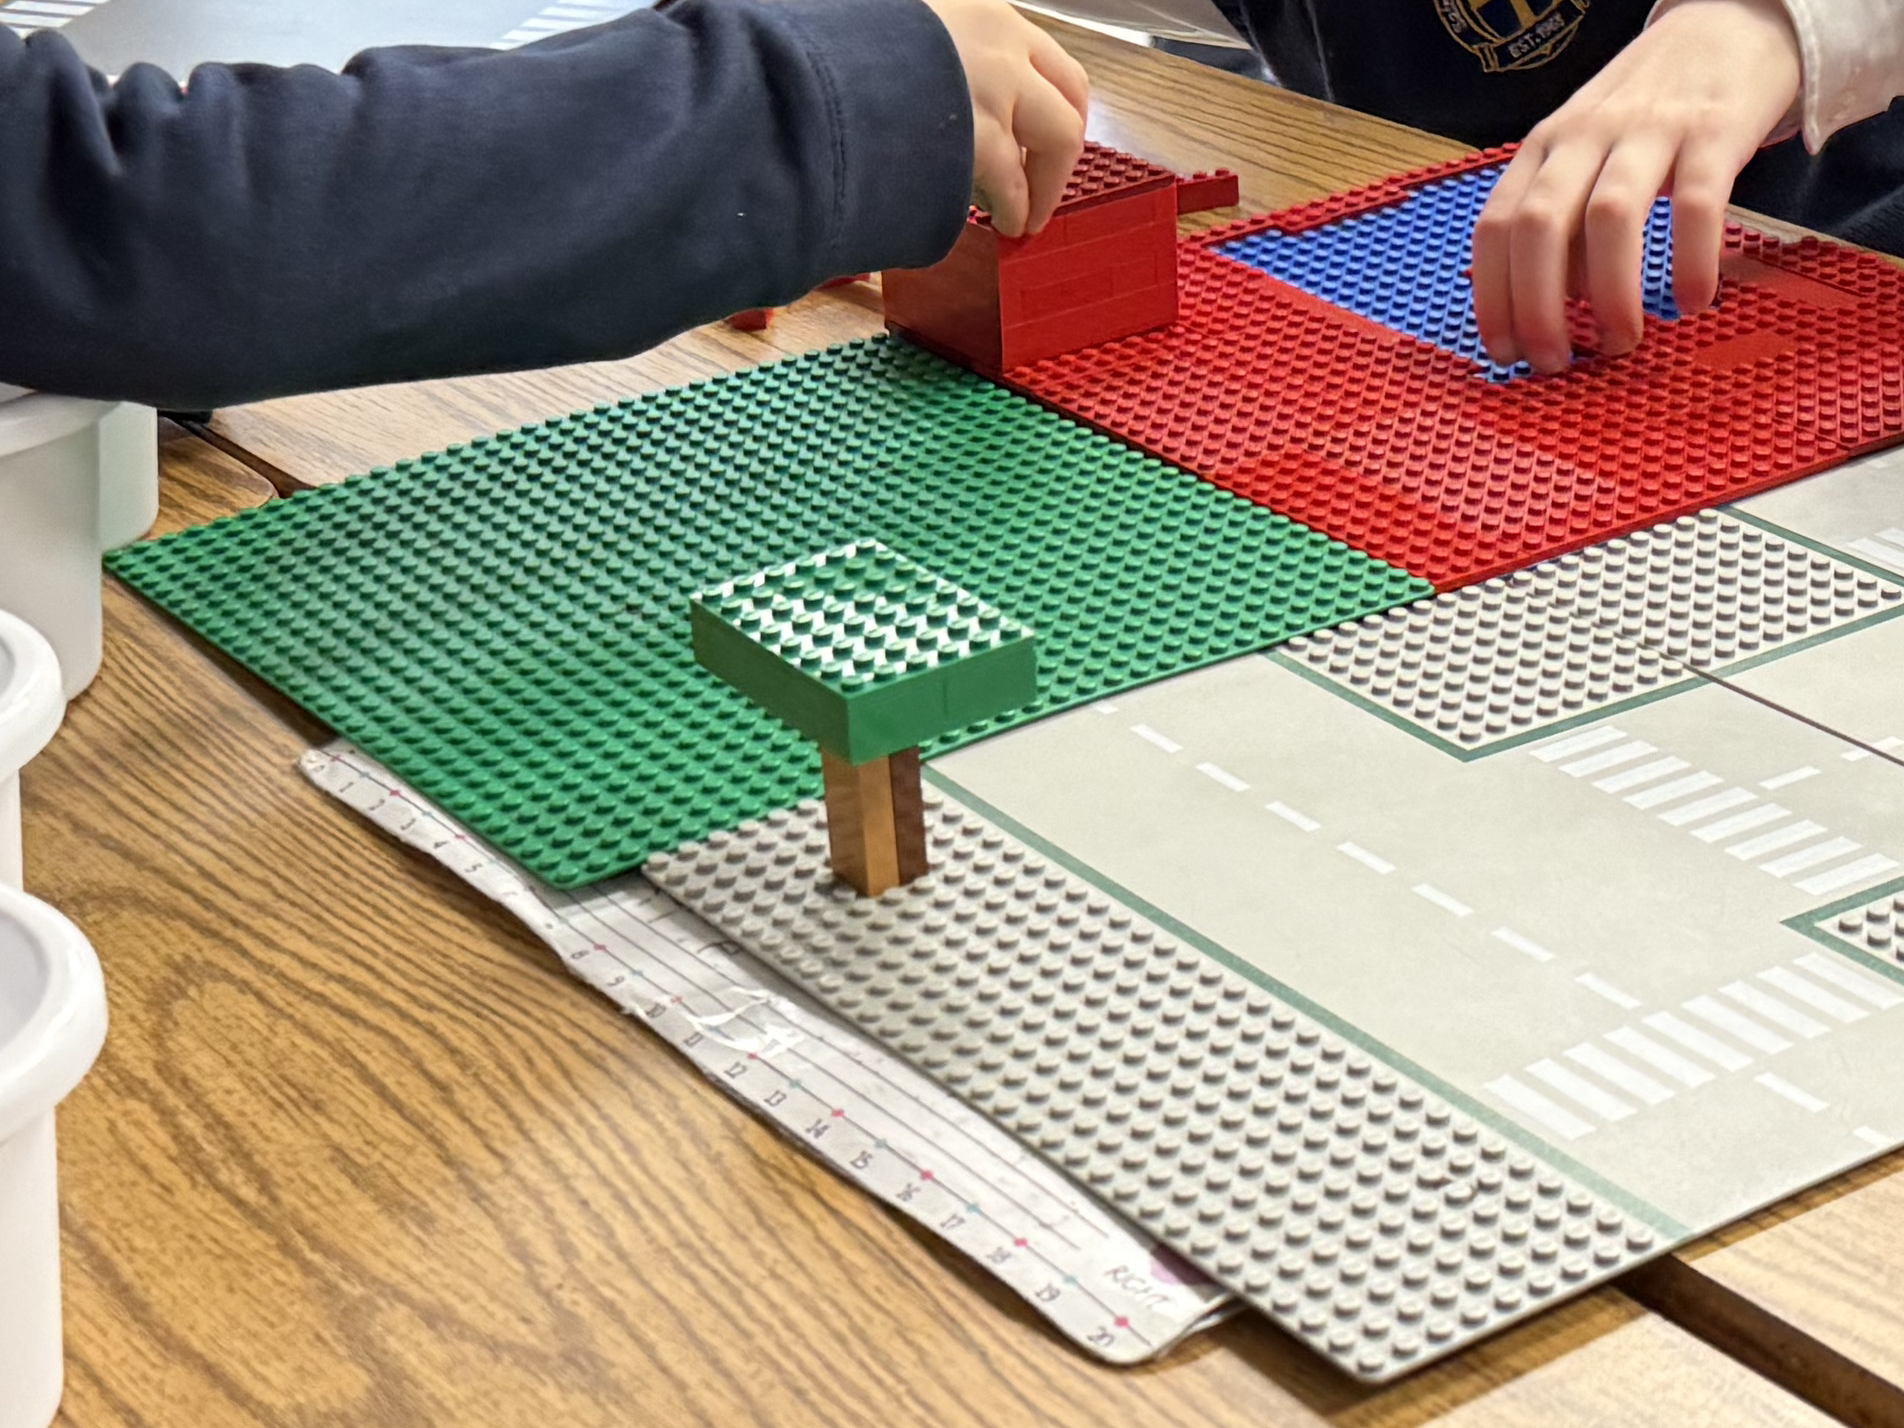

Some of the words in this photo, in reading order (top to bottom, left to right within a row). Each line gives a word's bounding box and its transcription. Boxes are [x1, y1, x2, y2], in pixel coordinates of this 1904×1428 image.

[724, 1061, 747, 1079] 12
[764, 1090, 787, 1107] 13
[805, 1118, 831, 1139] 14
[849, 1150, 874, 1170] 15
[895, 1183, 921, 1202] 16
[940, 1213, 966, 1230] 17
[1034, 1283, 1061, 1303] 19
[1086, 1325, 1116, 1348] 20
